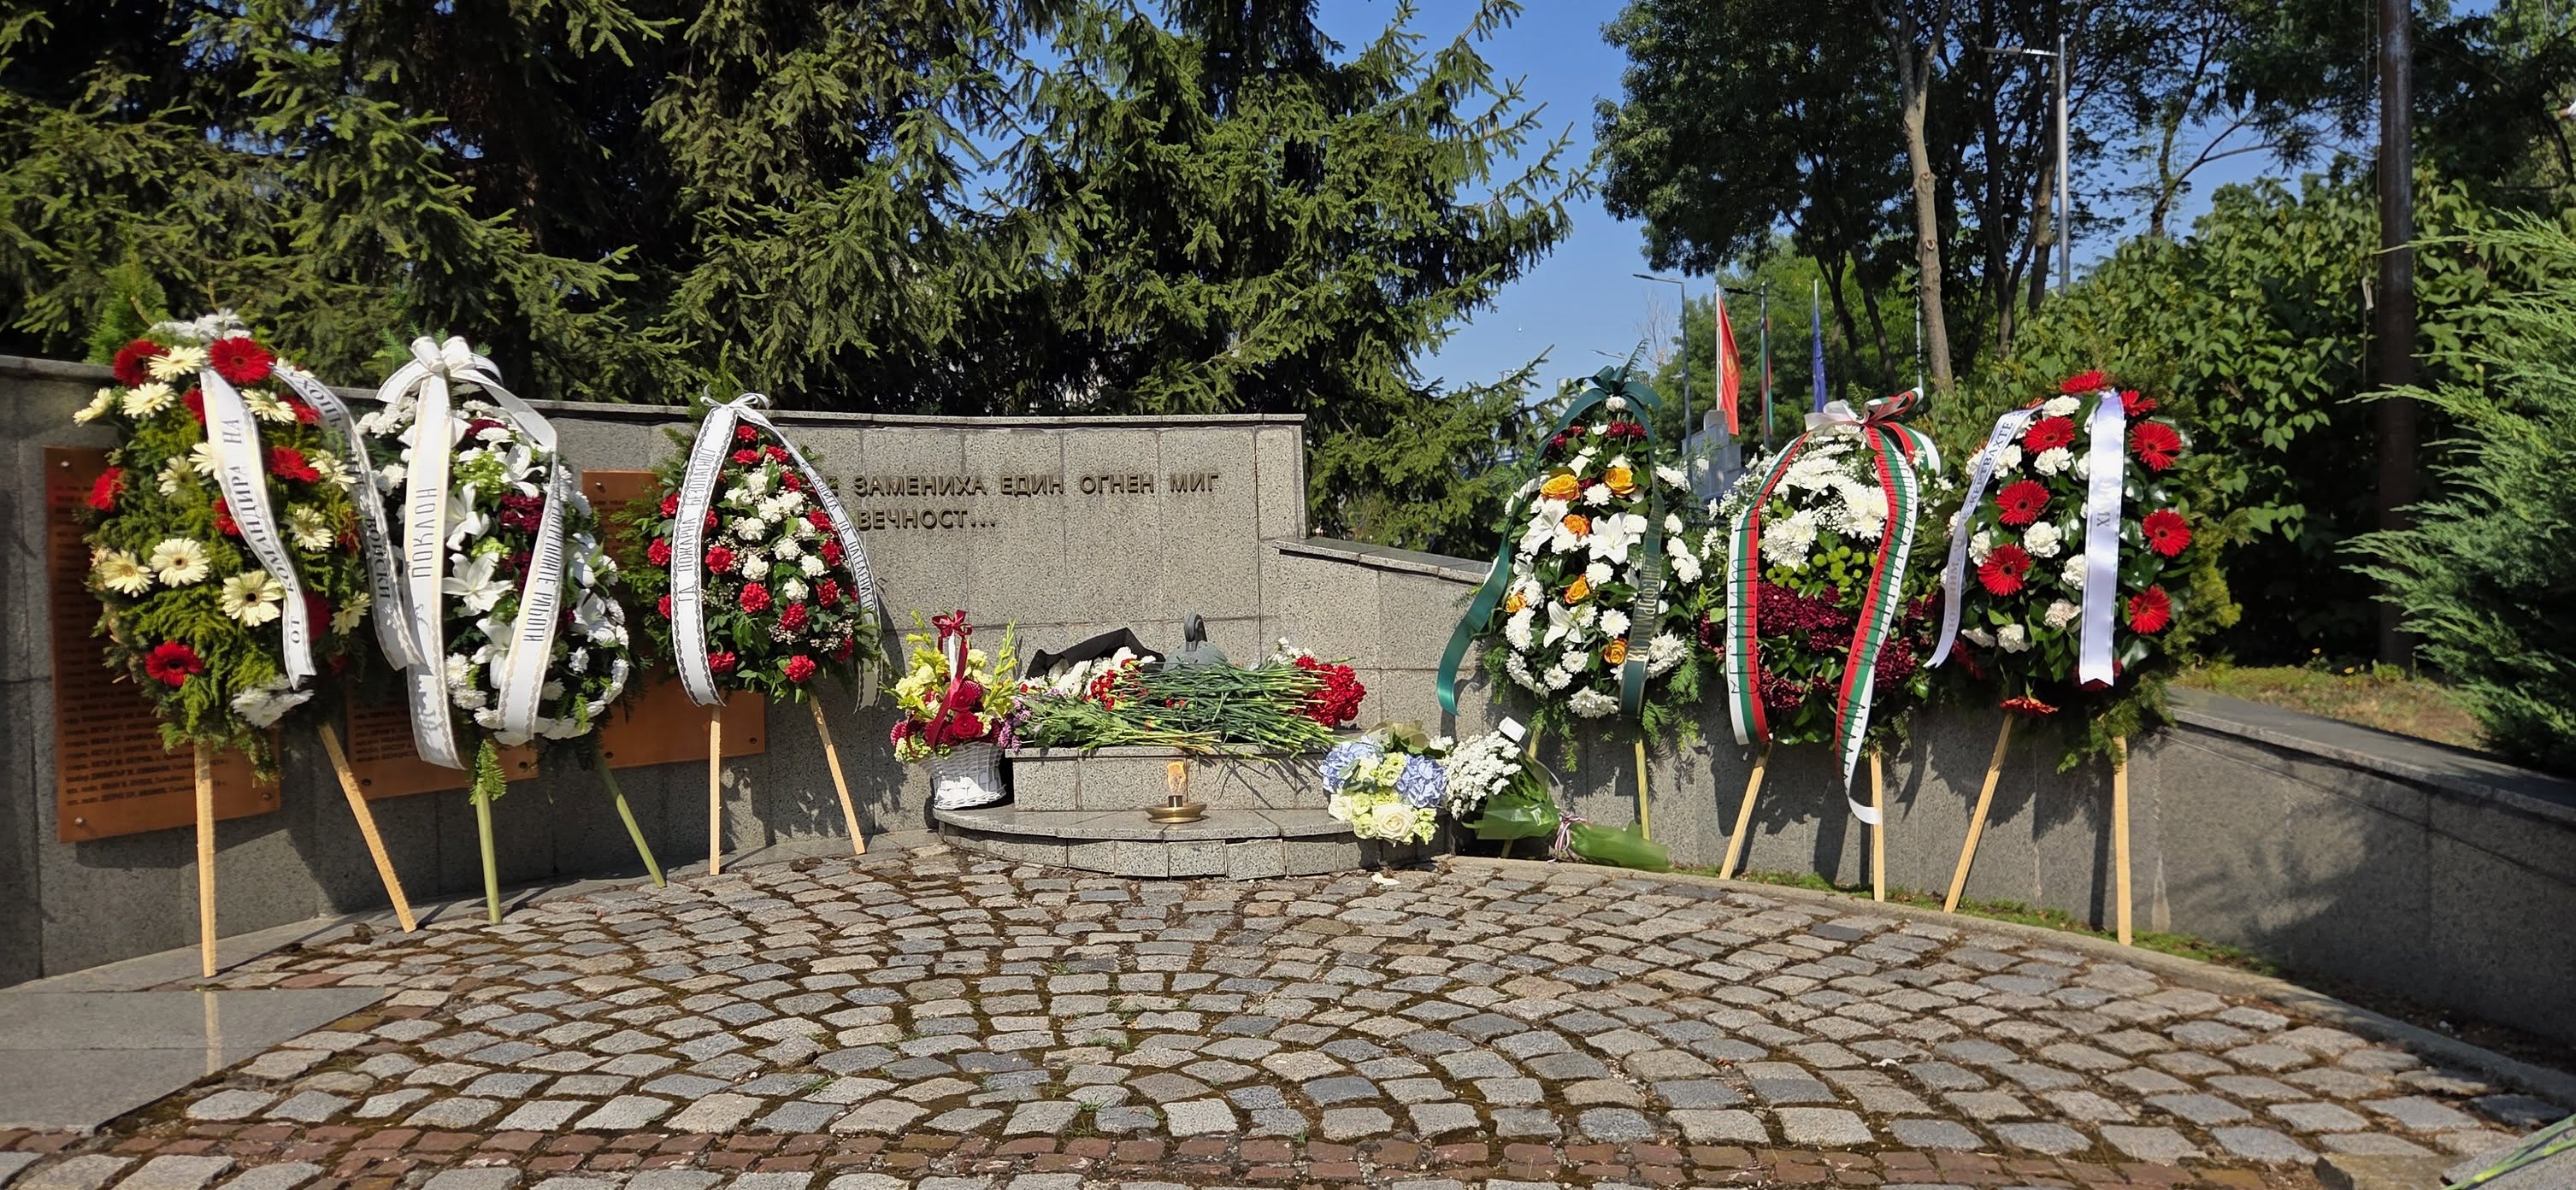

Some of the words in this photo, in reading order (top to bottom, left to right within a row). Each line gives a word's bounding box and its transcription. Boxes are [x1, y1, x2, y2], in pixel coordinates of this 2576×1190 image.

[221, 418, 242, 445] НА
[685, 447, 716, 506] БЕЗОПАСНОСТ
[853, 474, 987, 497] ЗАМЕНИХА
[1000, 473, 1064, 498] ЕДИН
[1080, 472, 1154, 496] ОГНЕН
[1170, 471, 1219, 493] МИГ
[227, 465, 294, 592] КОМАНДИРА
[411, 487, 438, 579] ПОКЛОН
[838, 520, 851, 535] НА
[857, 508, 997, 531] ВЕЧНОСТ...
[678, 516, 698, 572] ПОЖАРНА
[678, 584, 696, 602] ГД
[289, 616, 301, 645] ОТ
[522, 592, 553, 642] РАБОТИ
